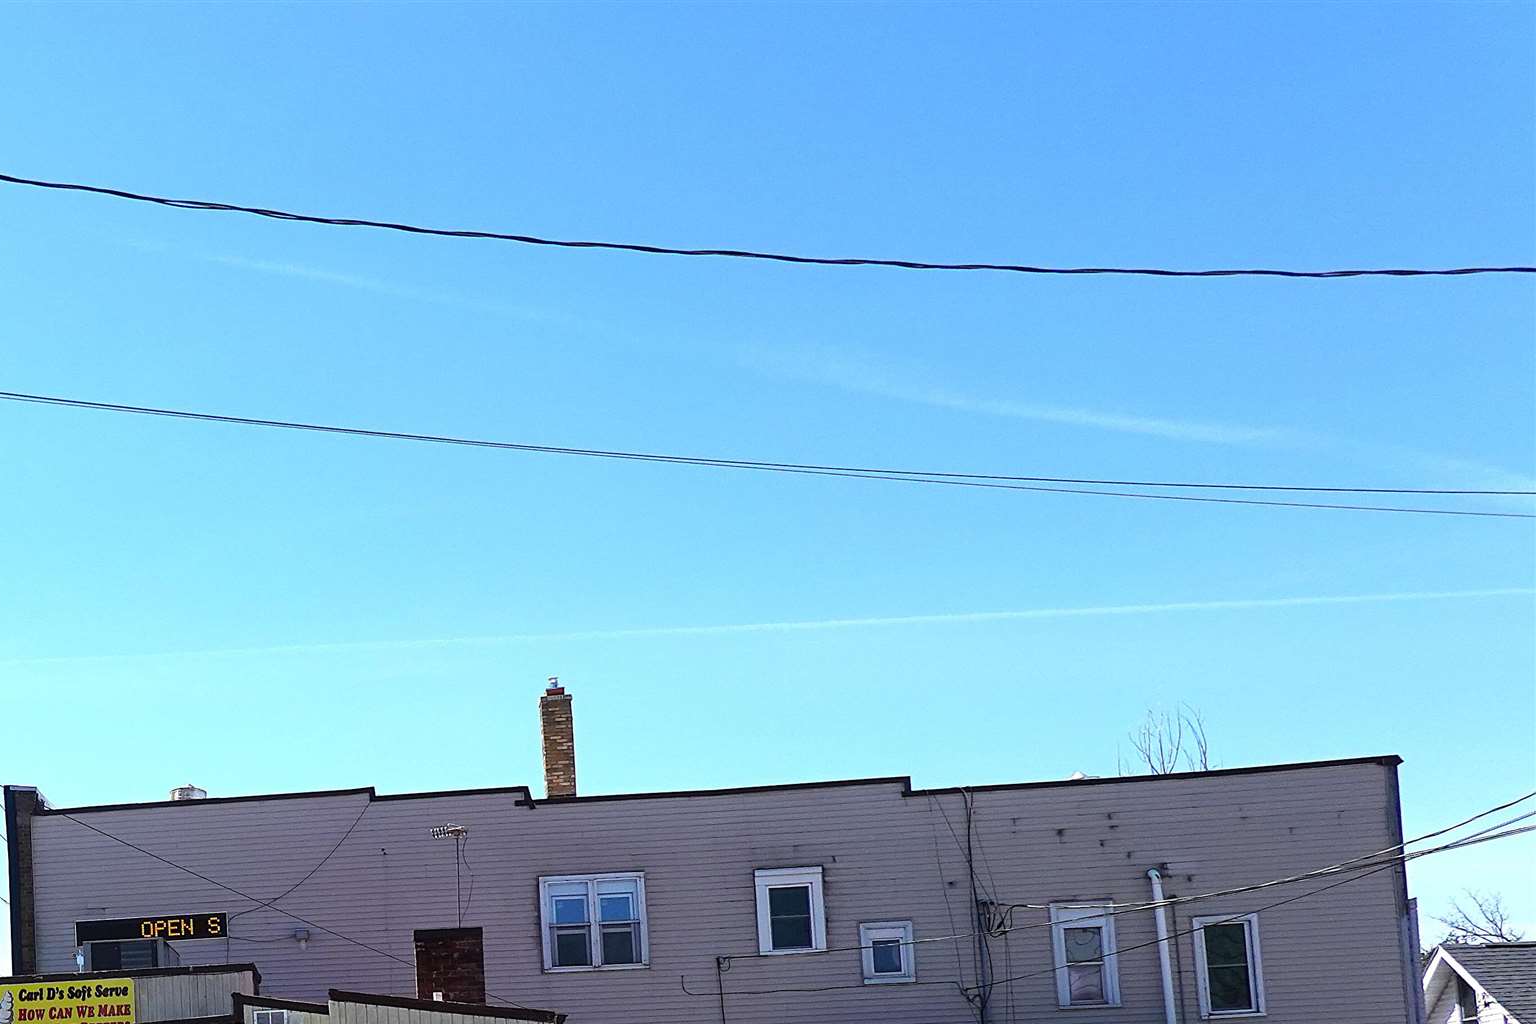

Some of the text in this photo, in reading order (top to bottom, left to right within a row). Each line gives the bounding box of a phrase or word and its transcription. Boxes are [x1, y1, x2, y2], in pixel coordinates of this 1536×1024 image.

[141, 916, 221, 938] OPEN S
[18, 985, 129, 1002] Carl D's Soft Serve
